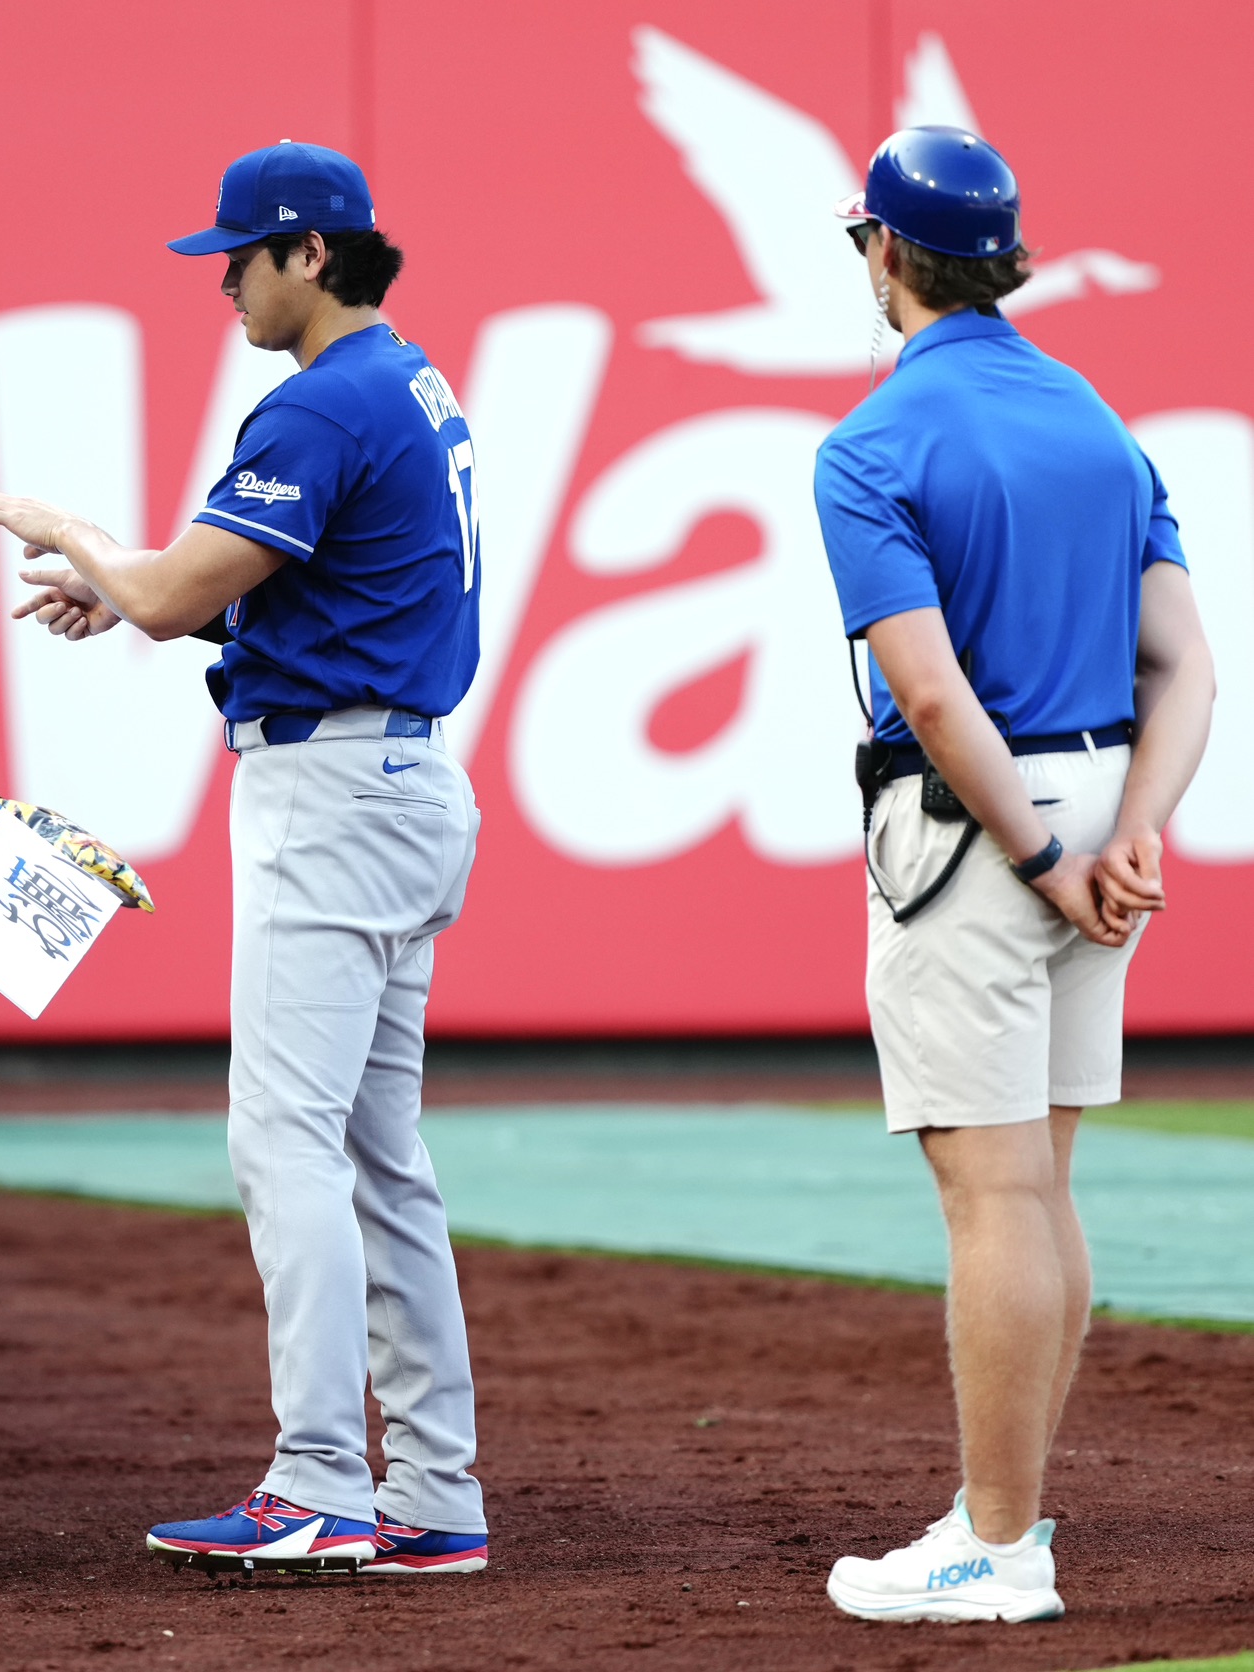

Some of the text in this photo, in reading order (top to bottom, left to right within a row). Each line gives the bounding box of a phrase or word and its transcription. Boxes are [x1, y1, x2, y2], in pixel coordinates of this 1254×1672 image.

[234, 471, 301, 505] Dodgers
[448, 439, 479, 594] 17
[927, 1556, 995, 1590] HOKA
